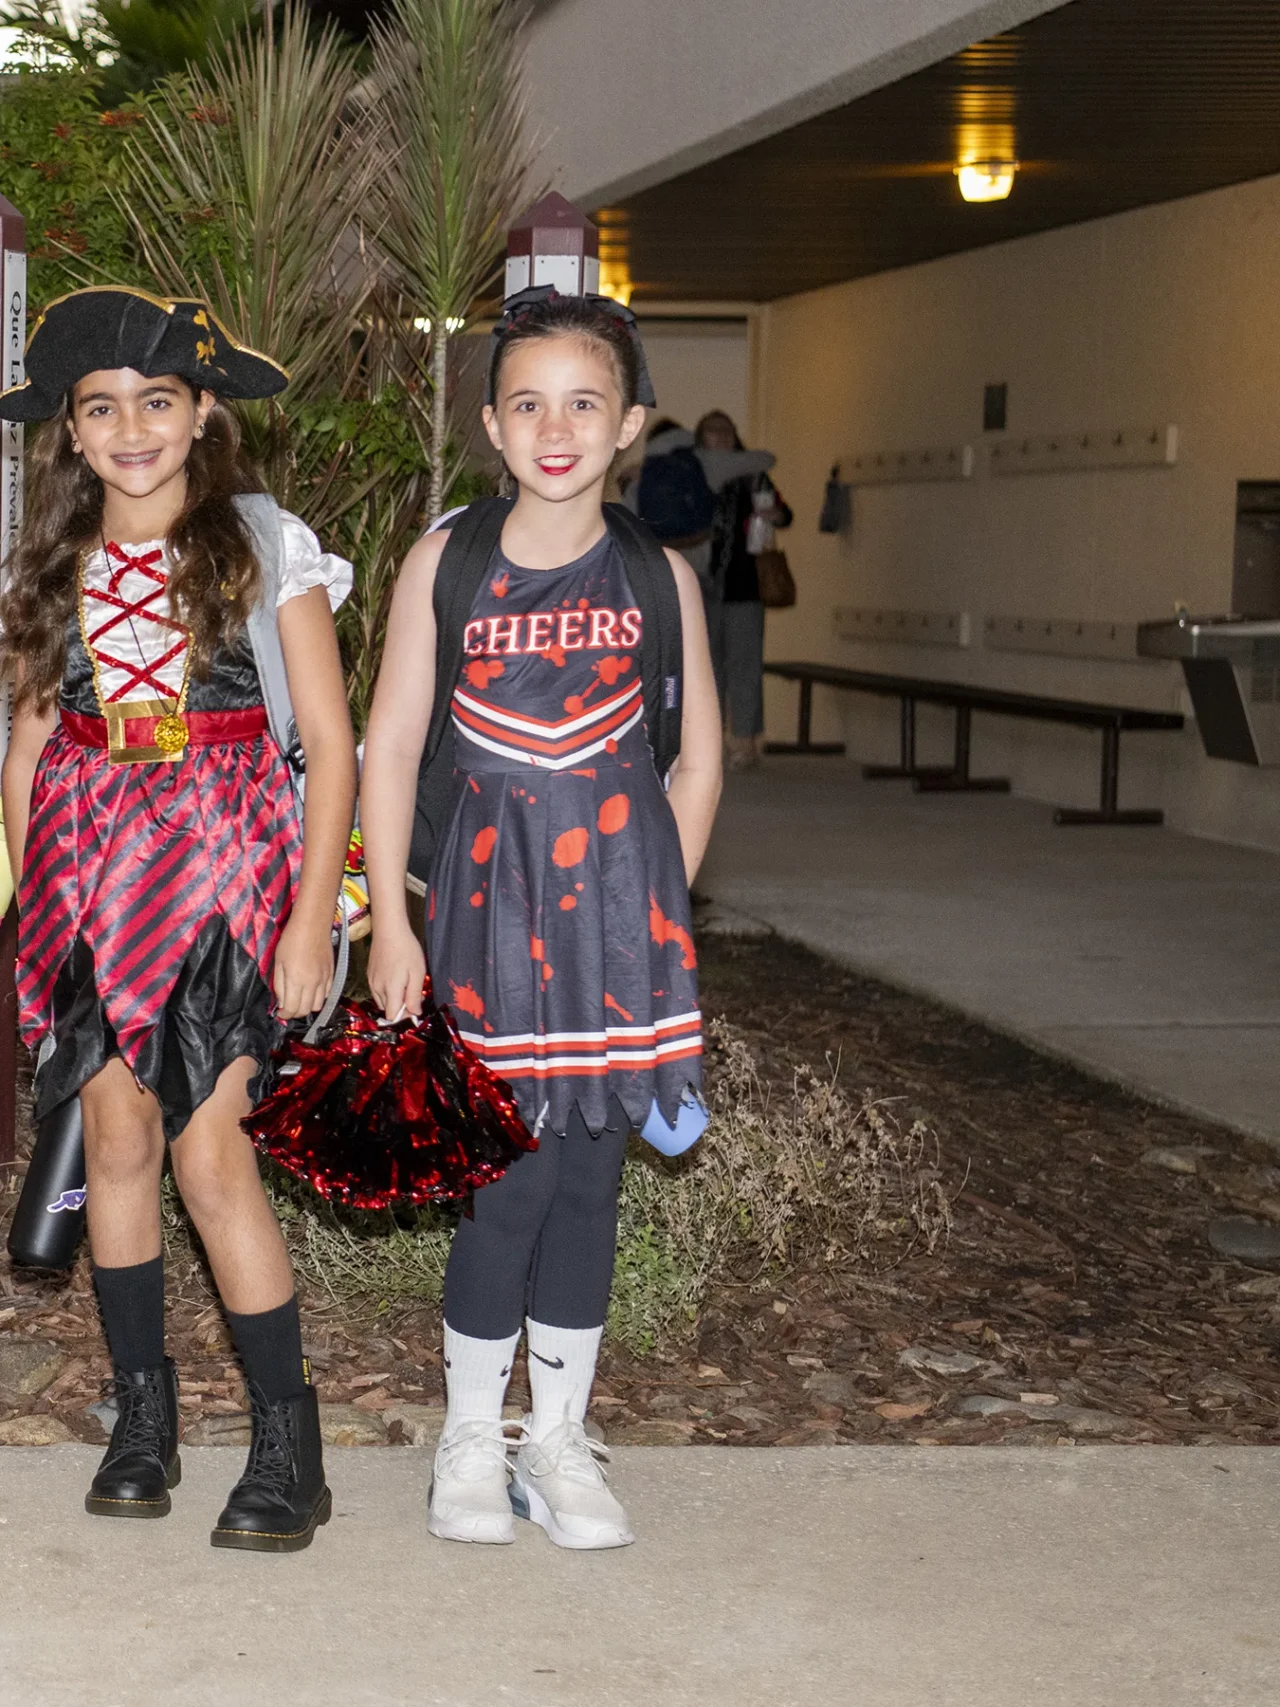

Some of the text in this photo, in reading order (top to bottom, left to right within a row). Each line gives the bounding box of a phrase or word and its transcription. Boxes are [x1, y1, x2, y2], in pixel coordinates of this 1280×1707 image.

[10, 291, 22, 348] Que
[11, 360, 21, 387] La
[463, 607, 642, 656] CHEERS
